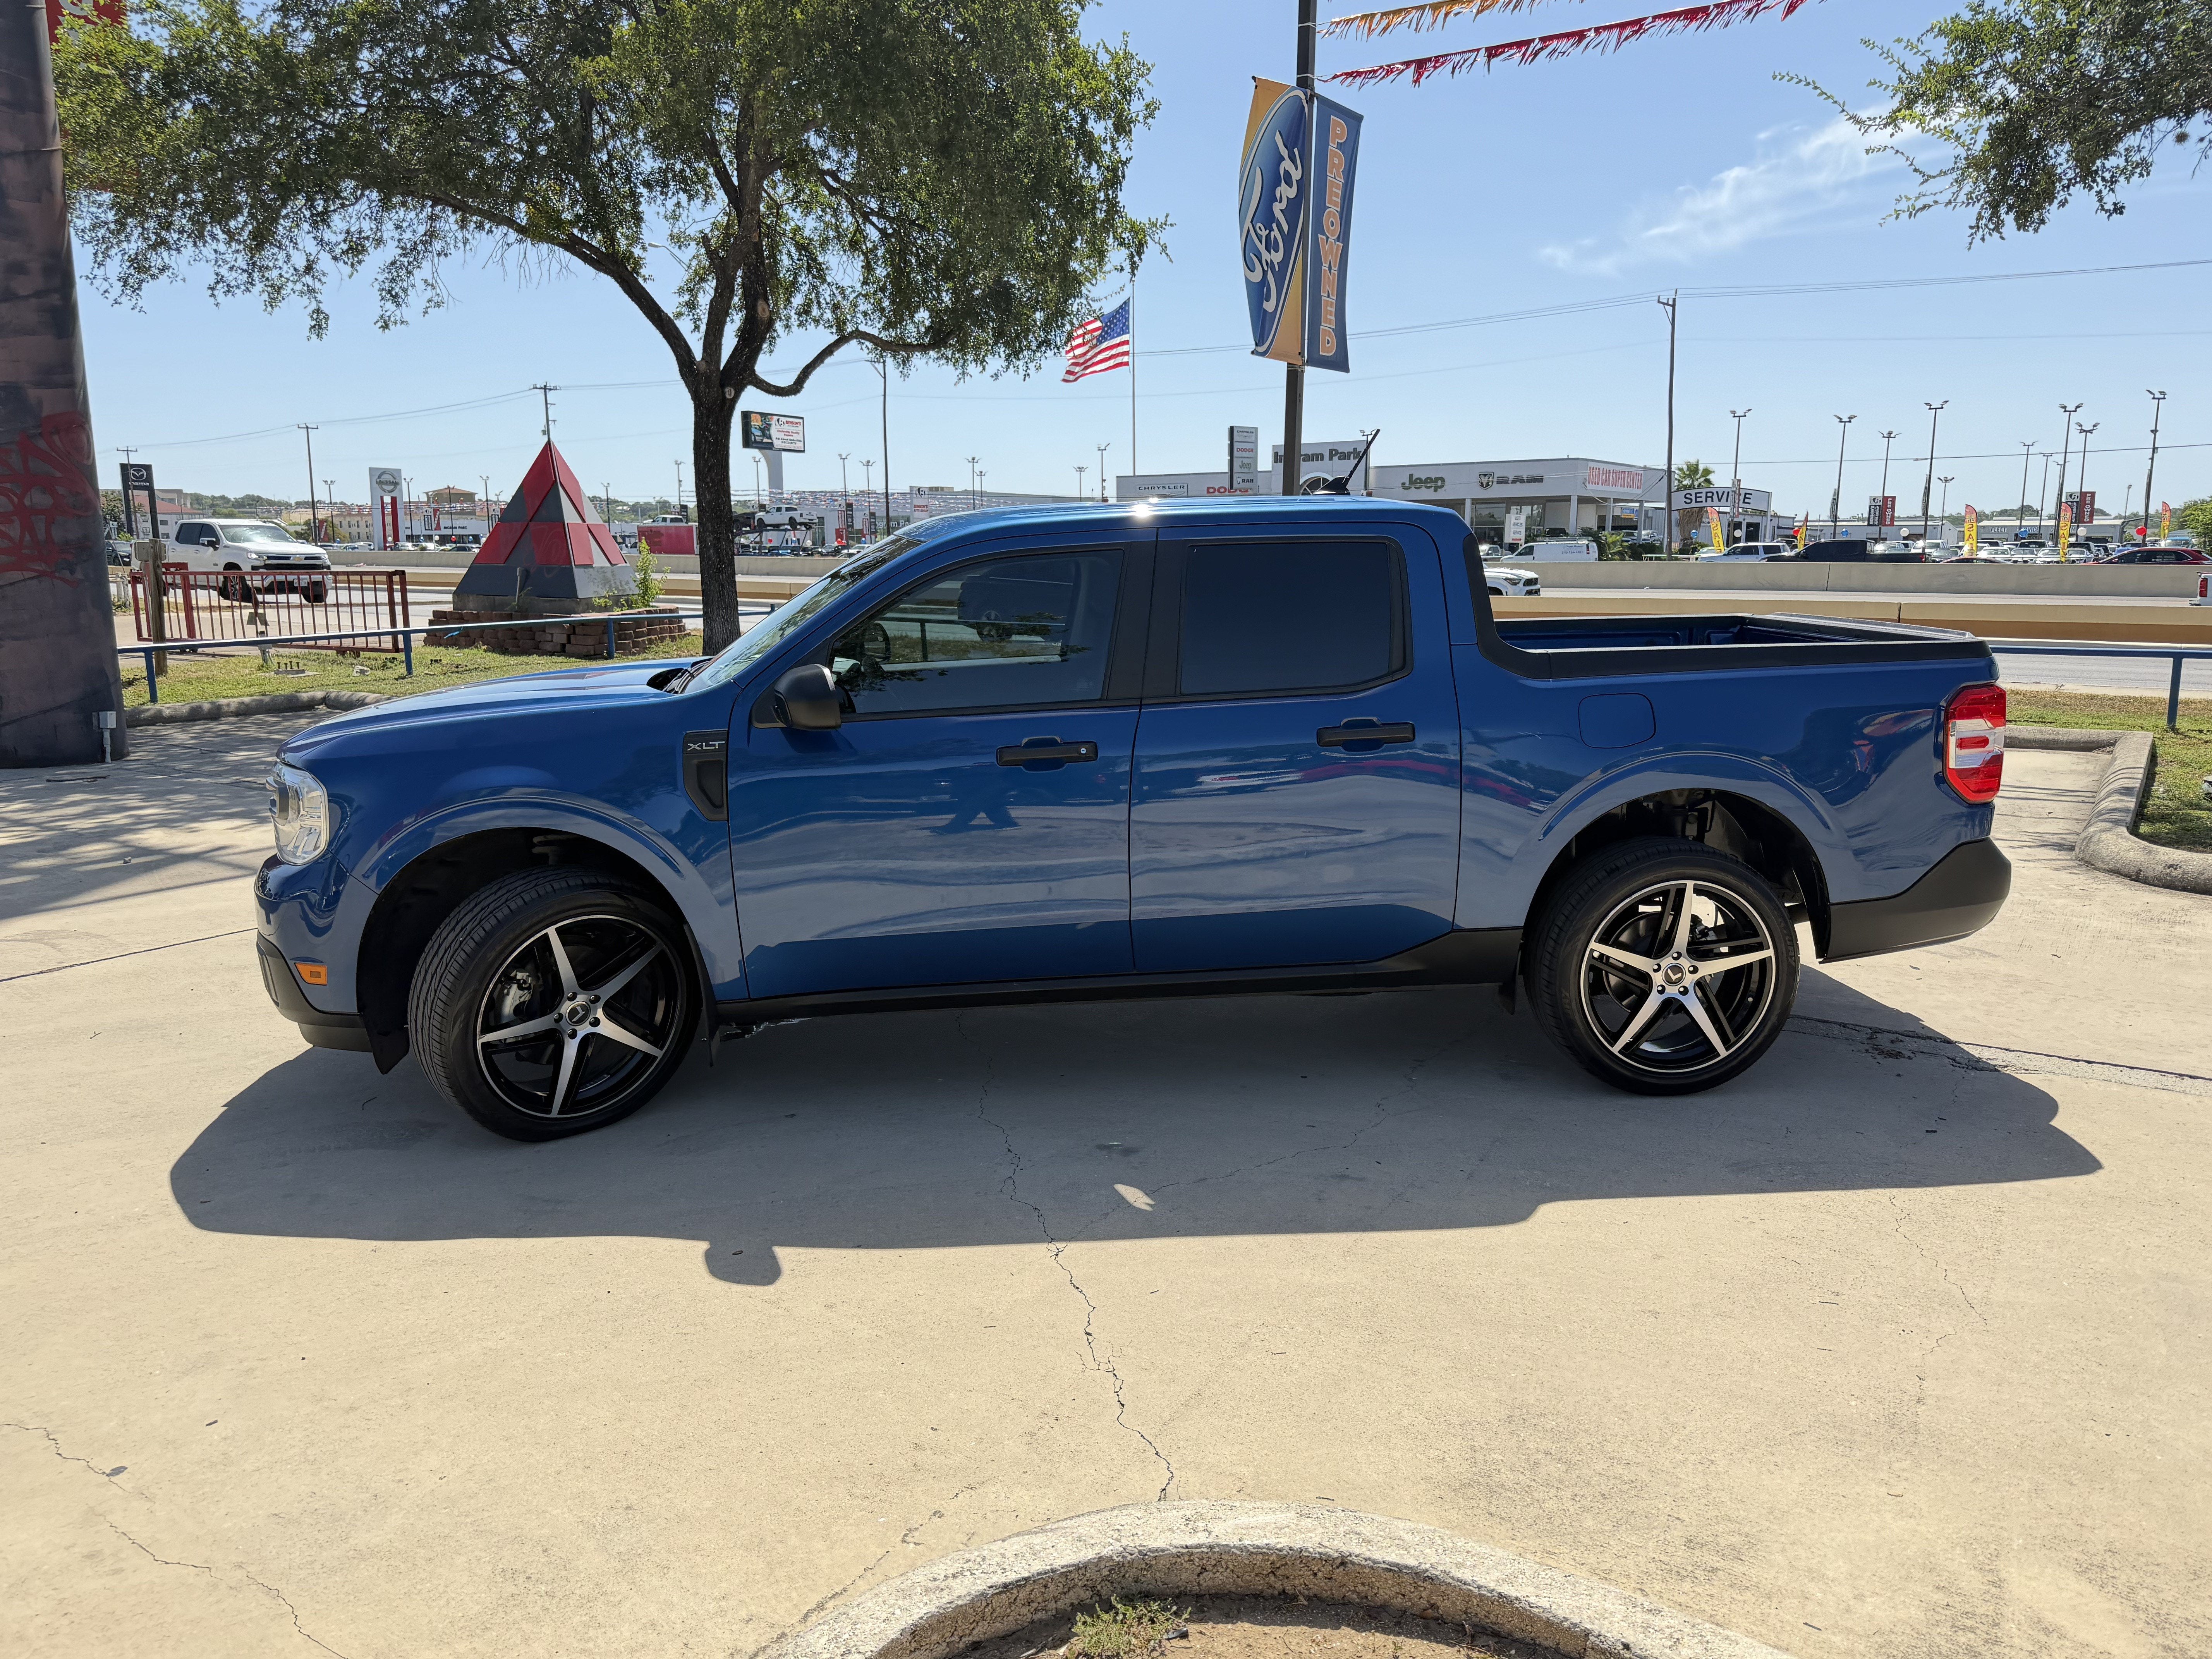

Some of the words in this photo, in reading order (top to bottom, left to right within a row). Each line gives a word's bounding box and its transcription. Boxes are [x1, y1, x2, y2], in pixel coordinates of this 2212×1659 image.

[1242, 130, 1302, 312] Ford
[1274, 452, 1324, 463] Inam
[1329, 448, 1362, 461] Park
[1401, 474, 1446, 492] Jeep
[1496, 475, 1544, 484] RAM
[1588, 466, 1601, 485] USED
[1601, 467, 1611, 486] CAR
[1611, 469, 1626, 488] SUPER
[1626, 471, 1642, 489] CENTER
[1684, 491, 1753, 505] SERVIE
[687, 741, 725, 750] XLT
